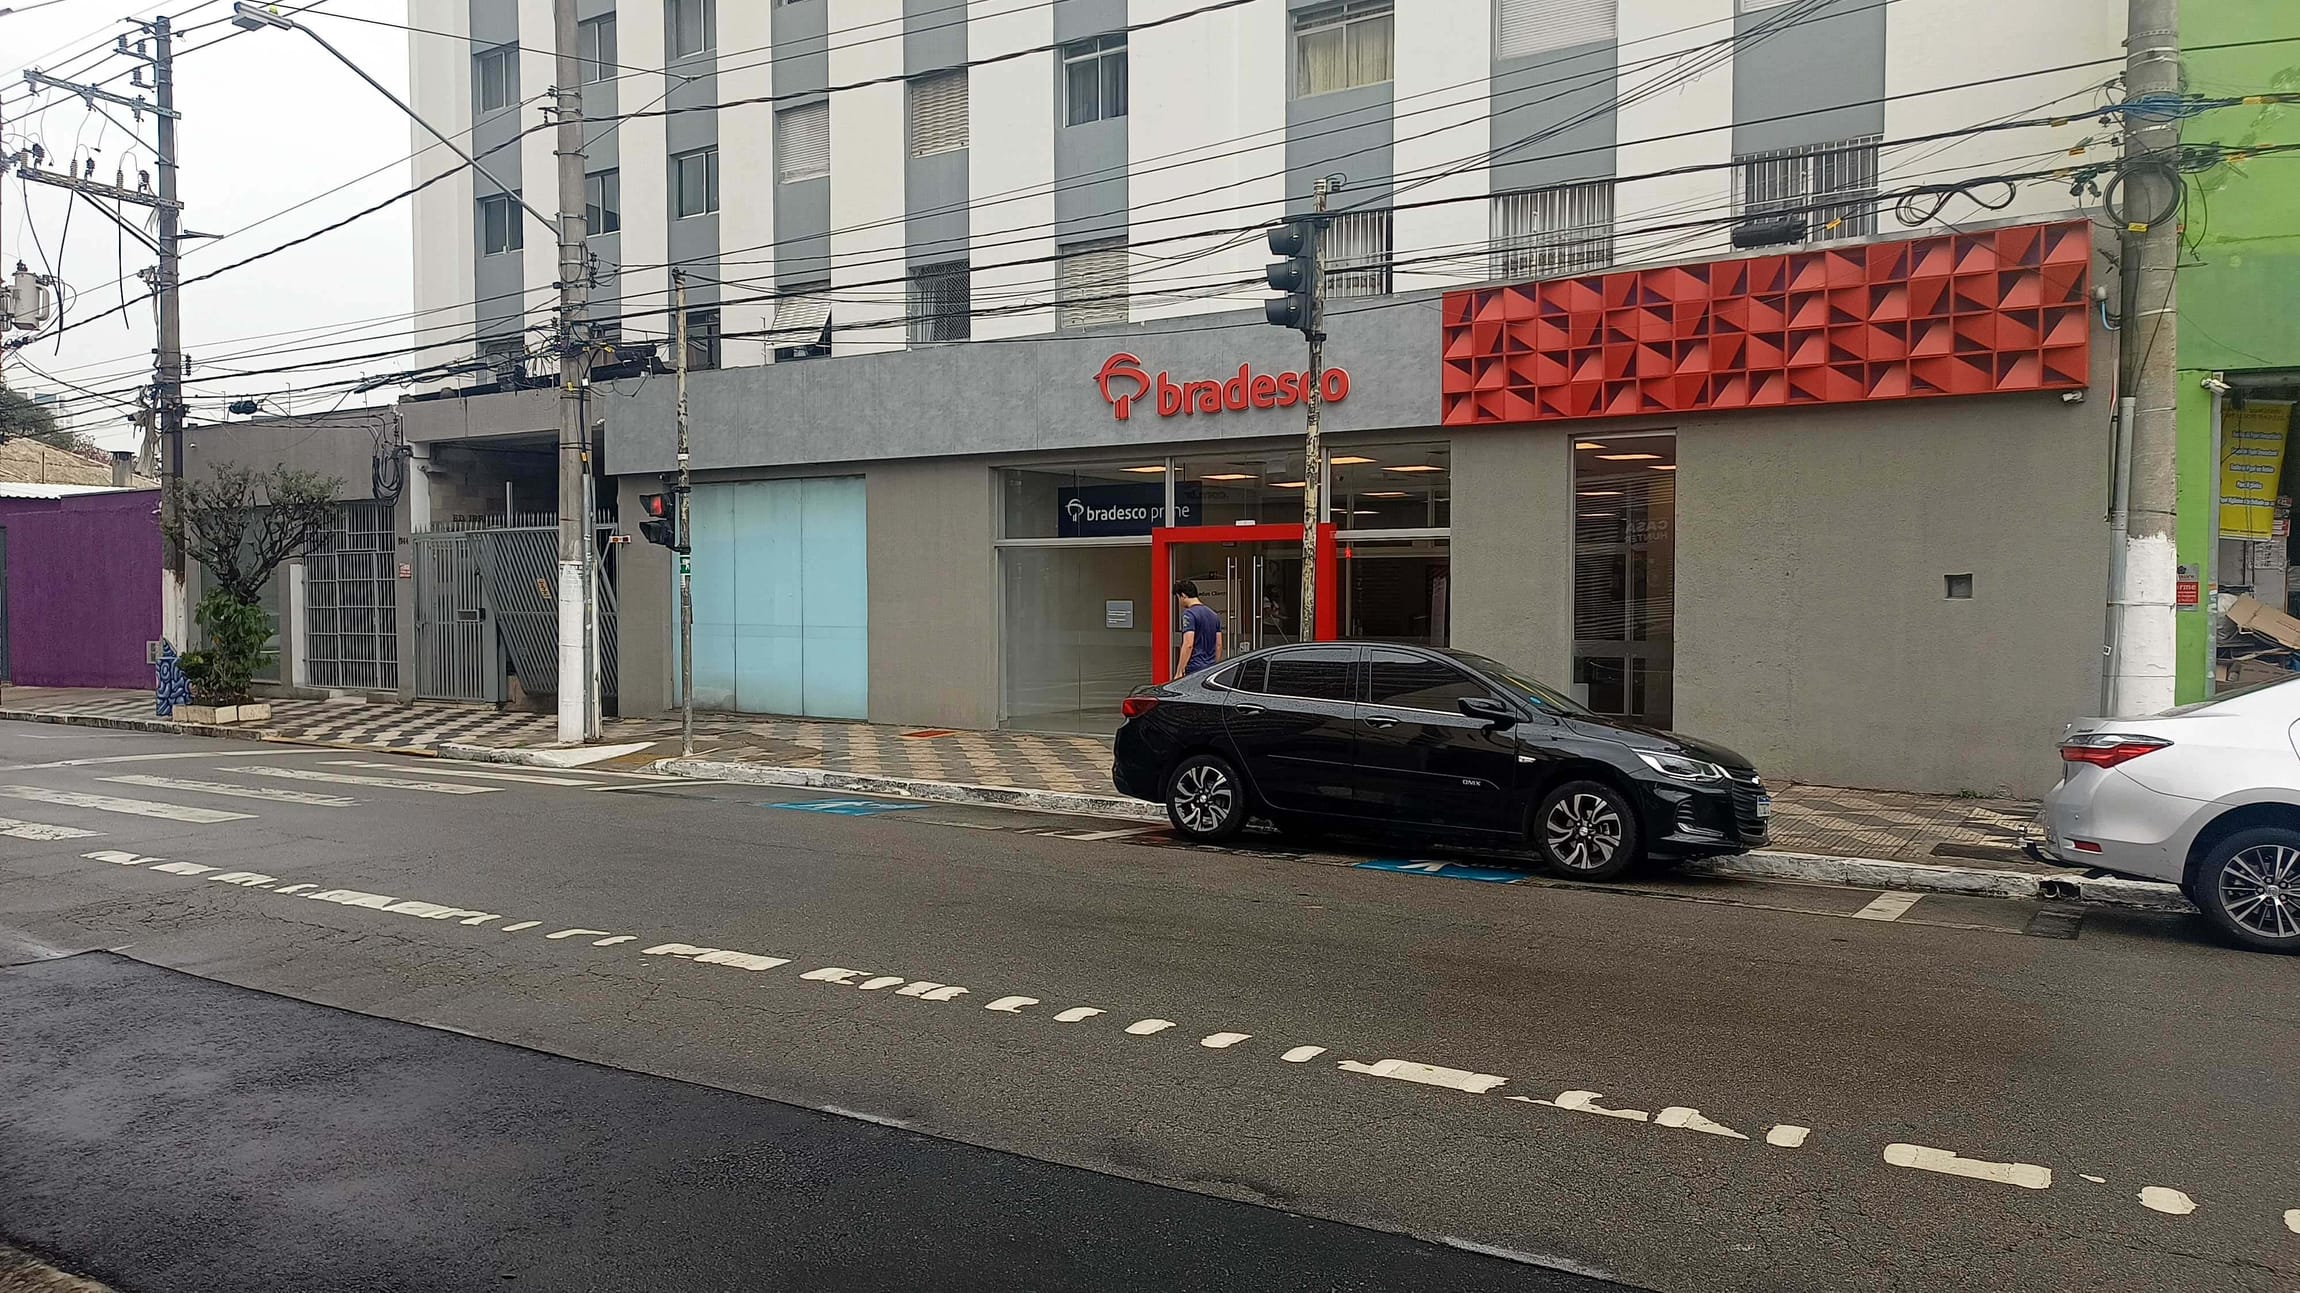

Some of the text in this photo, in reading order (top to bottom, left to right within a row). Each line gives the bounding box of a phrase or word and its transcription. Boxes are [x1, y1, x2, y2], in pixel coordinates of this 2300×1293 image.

[1157, 362, 1350, 416] bradesco
[1087, 505, 1190, 523] bradesco prme
